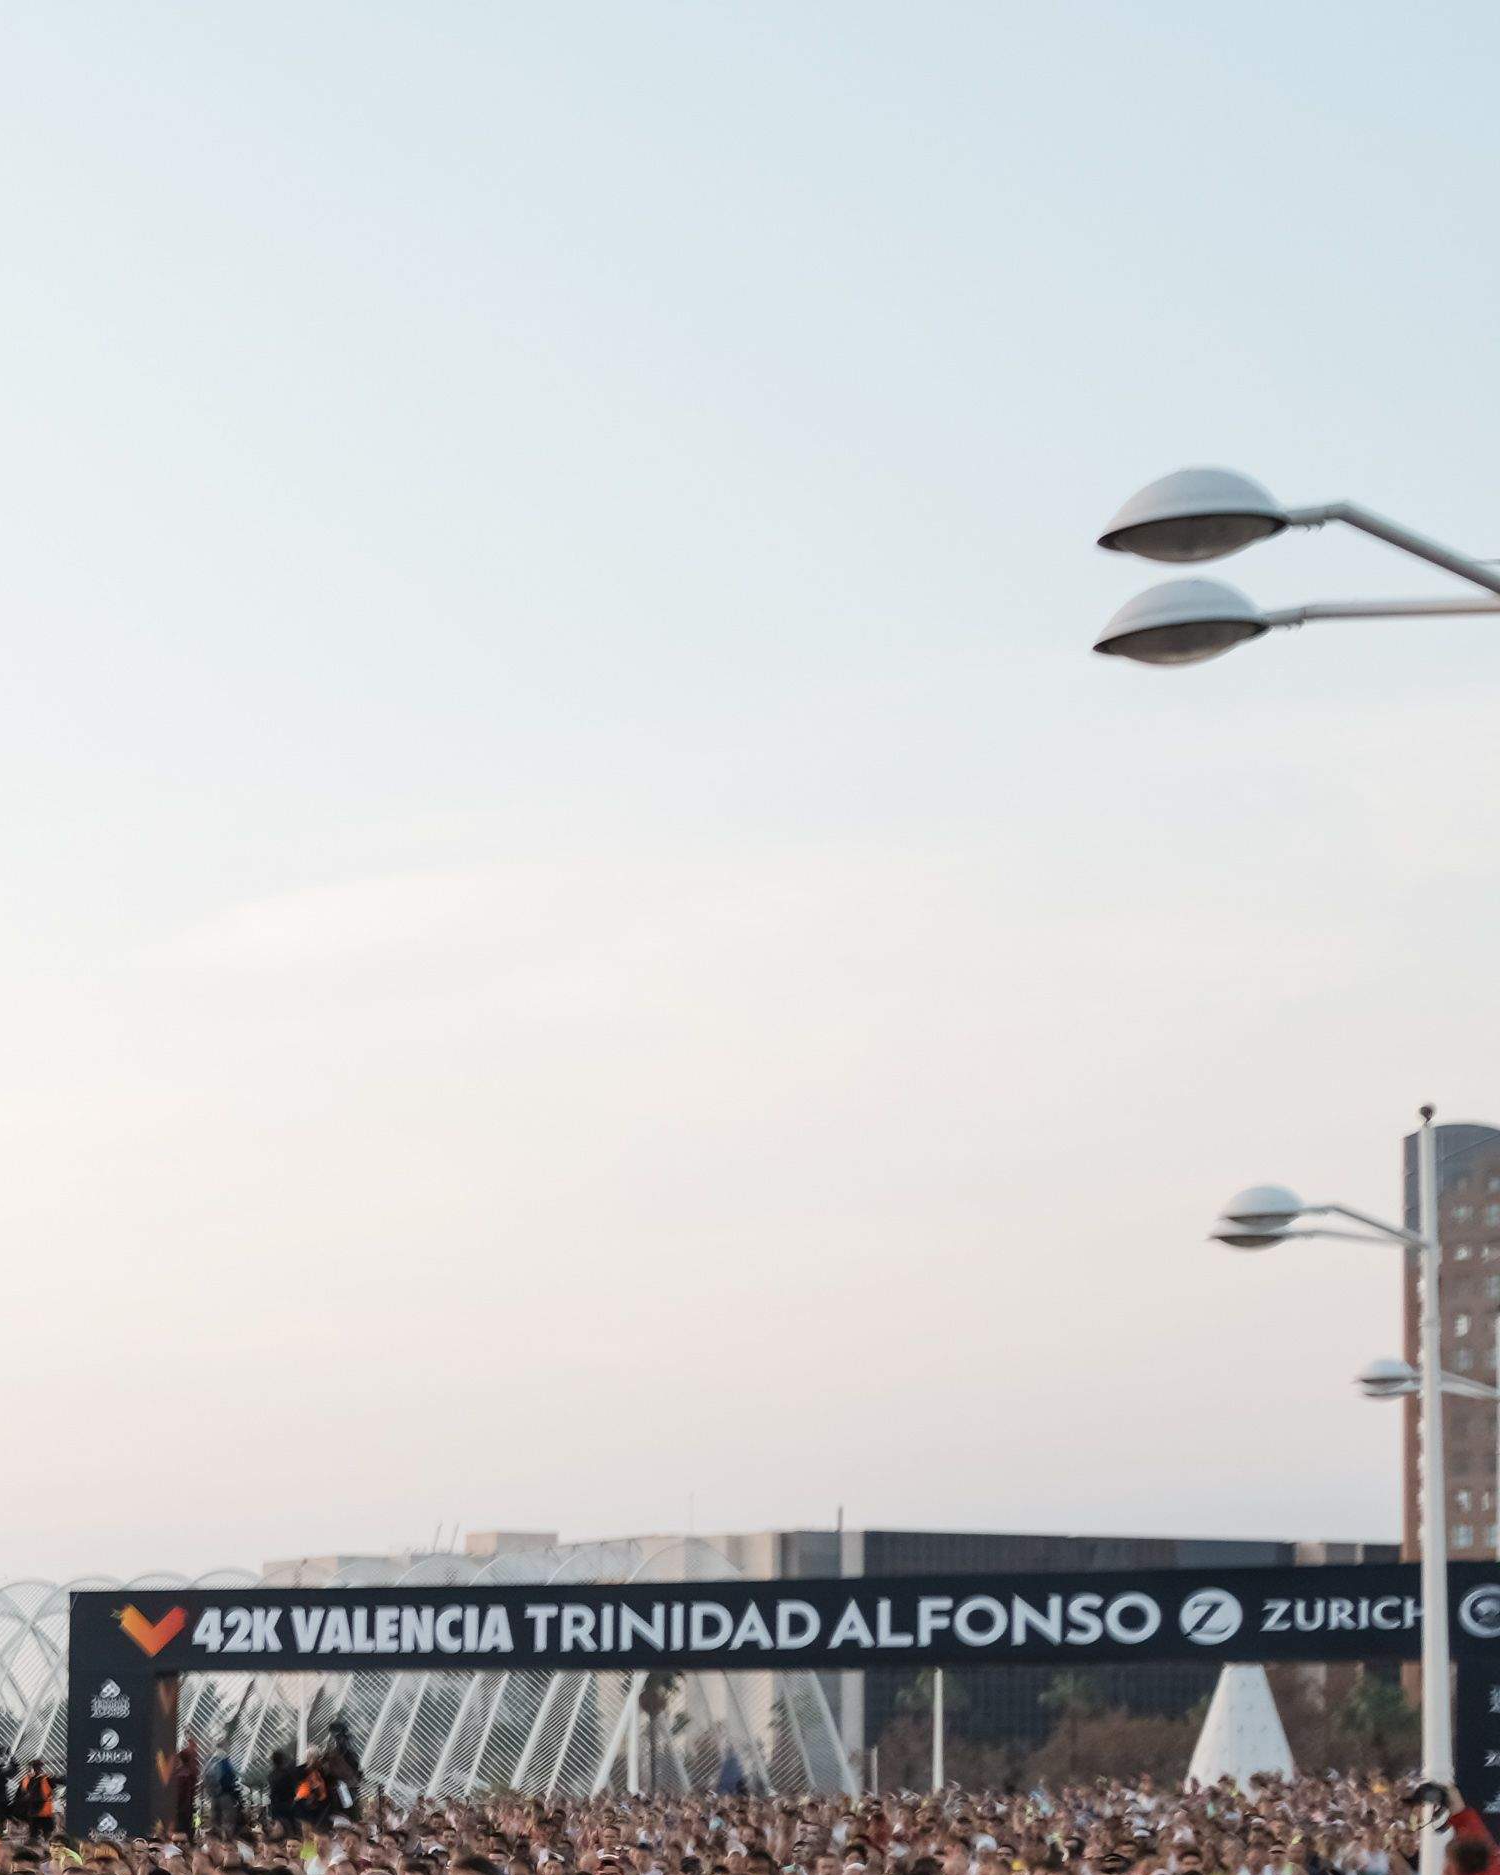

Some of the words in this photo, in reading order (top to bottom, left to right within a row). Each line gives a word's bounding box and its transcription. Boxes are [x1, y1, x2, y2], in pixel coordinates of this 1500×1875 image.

[191, 1606, 283, 1654] 42K
[290, 1605, 515, 1654] VALENCIA
[524, 1600, 822, 1653] TRINIDAD
[827, 1592, 1162, 1650] ALFONSO
